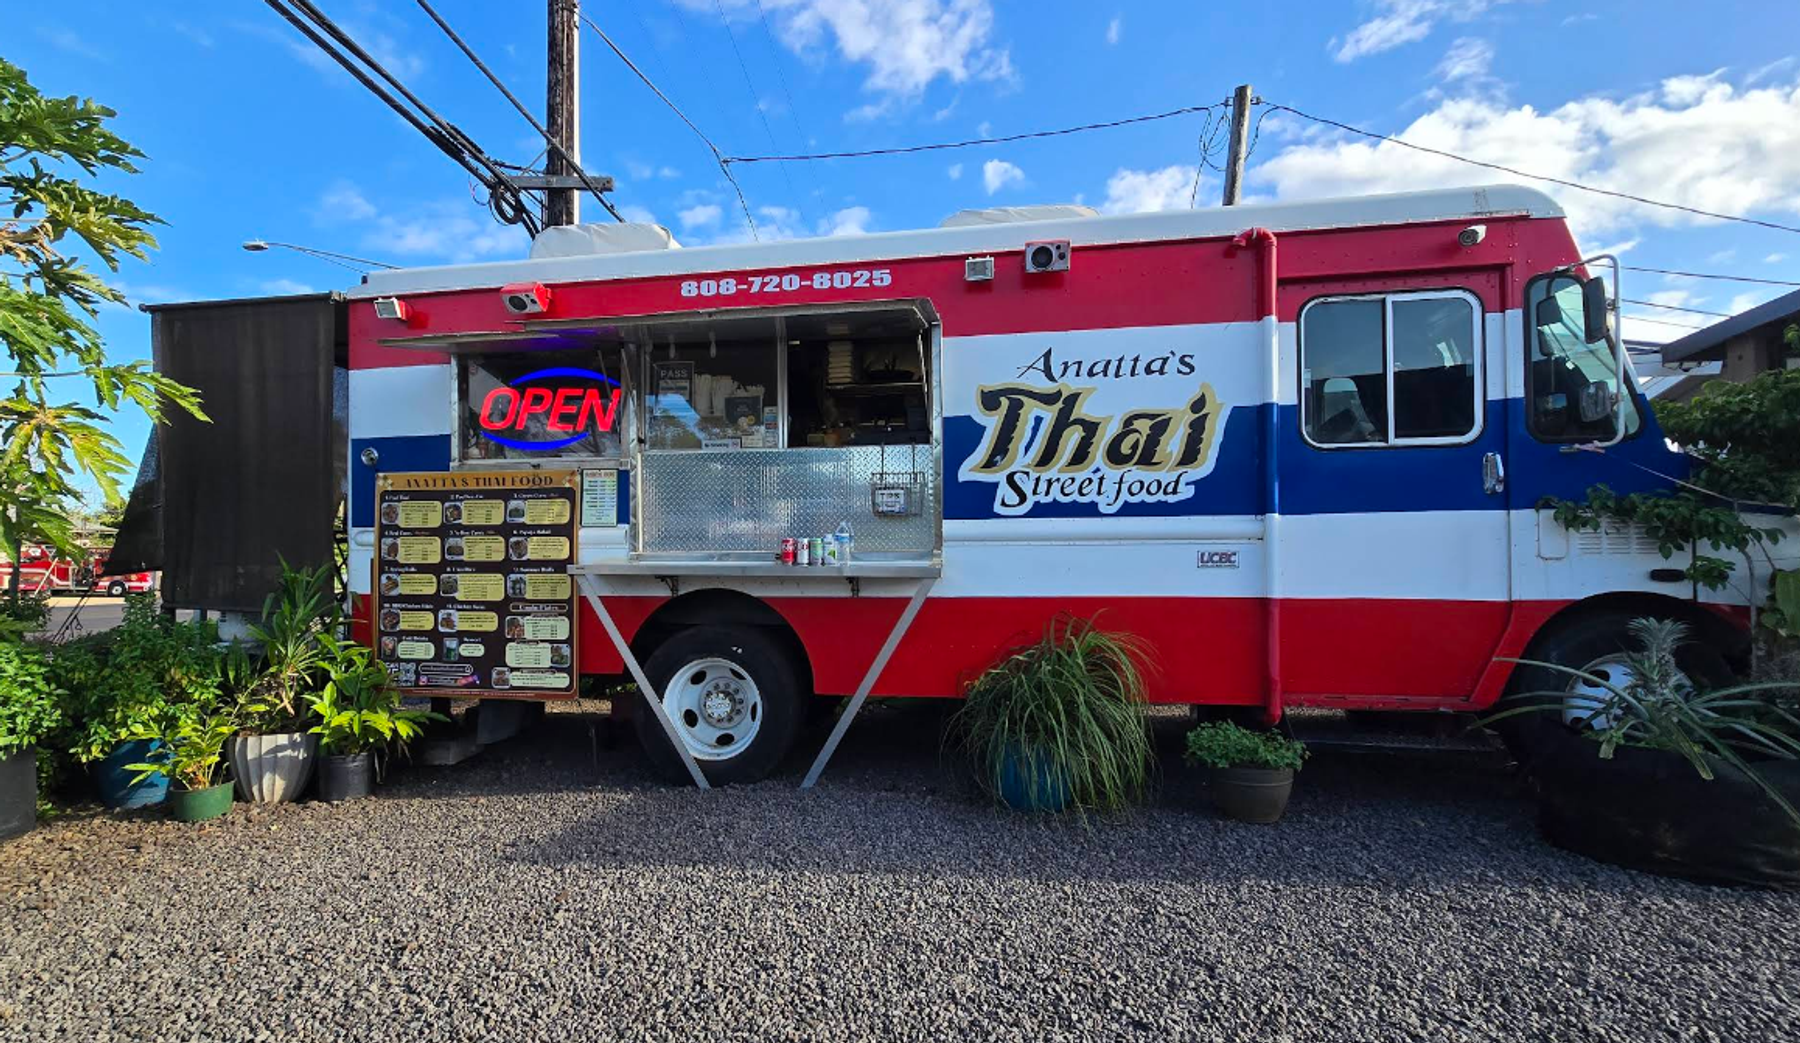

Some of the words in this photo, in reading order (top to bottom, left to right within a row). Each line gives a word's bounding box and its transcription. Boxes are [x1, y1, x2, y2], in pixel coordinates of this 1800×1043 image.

[680, 269, 892, 297] 808-720-8025
[660, 369, 688, 379] PASS
[1016, 347, 1196, 382] Anatta's
[479, 387, 621, 432] OPEN
[975, 384, 1214, 471] Thai
[473, 476, 506, 487] THAI
[511, 475, 553, 487] FOOD
[1000, 469, 1106, 508] Street
[1105, 469, 1189, 506] food
